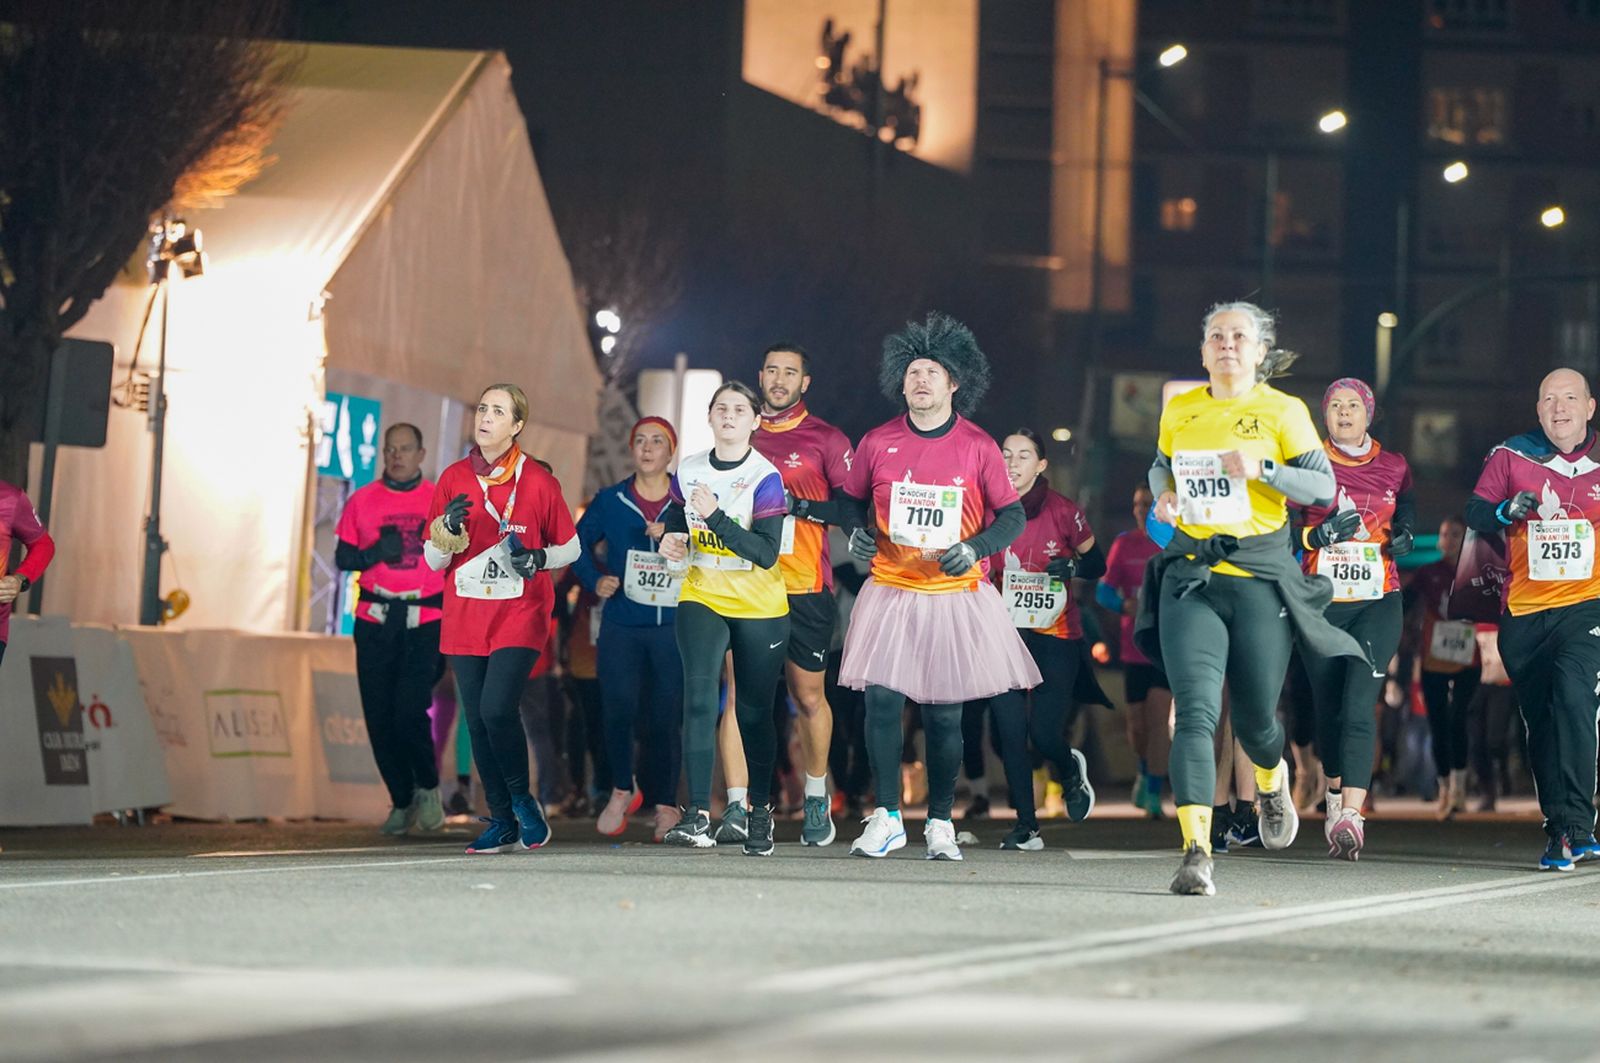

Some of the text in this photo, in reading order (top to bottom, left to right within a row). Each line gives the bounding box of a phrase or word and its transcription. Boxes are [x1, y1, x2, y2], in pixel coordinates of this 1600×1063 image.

[907, 490, 928, 498] NOCHE
[1186, 477, 1231, 498] 3479
[899, 497, 912, 505] SAN
[907, 506, 944, 528] 7170
[1541, 541, 1581, 560] 2573
[638, 570, 672, 588] 3427
[1332, 563, 1371, 581] 1368
[1014, 591, 1055, 609] 2955
